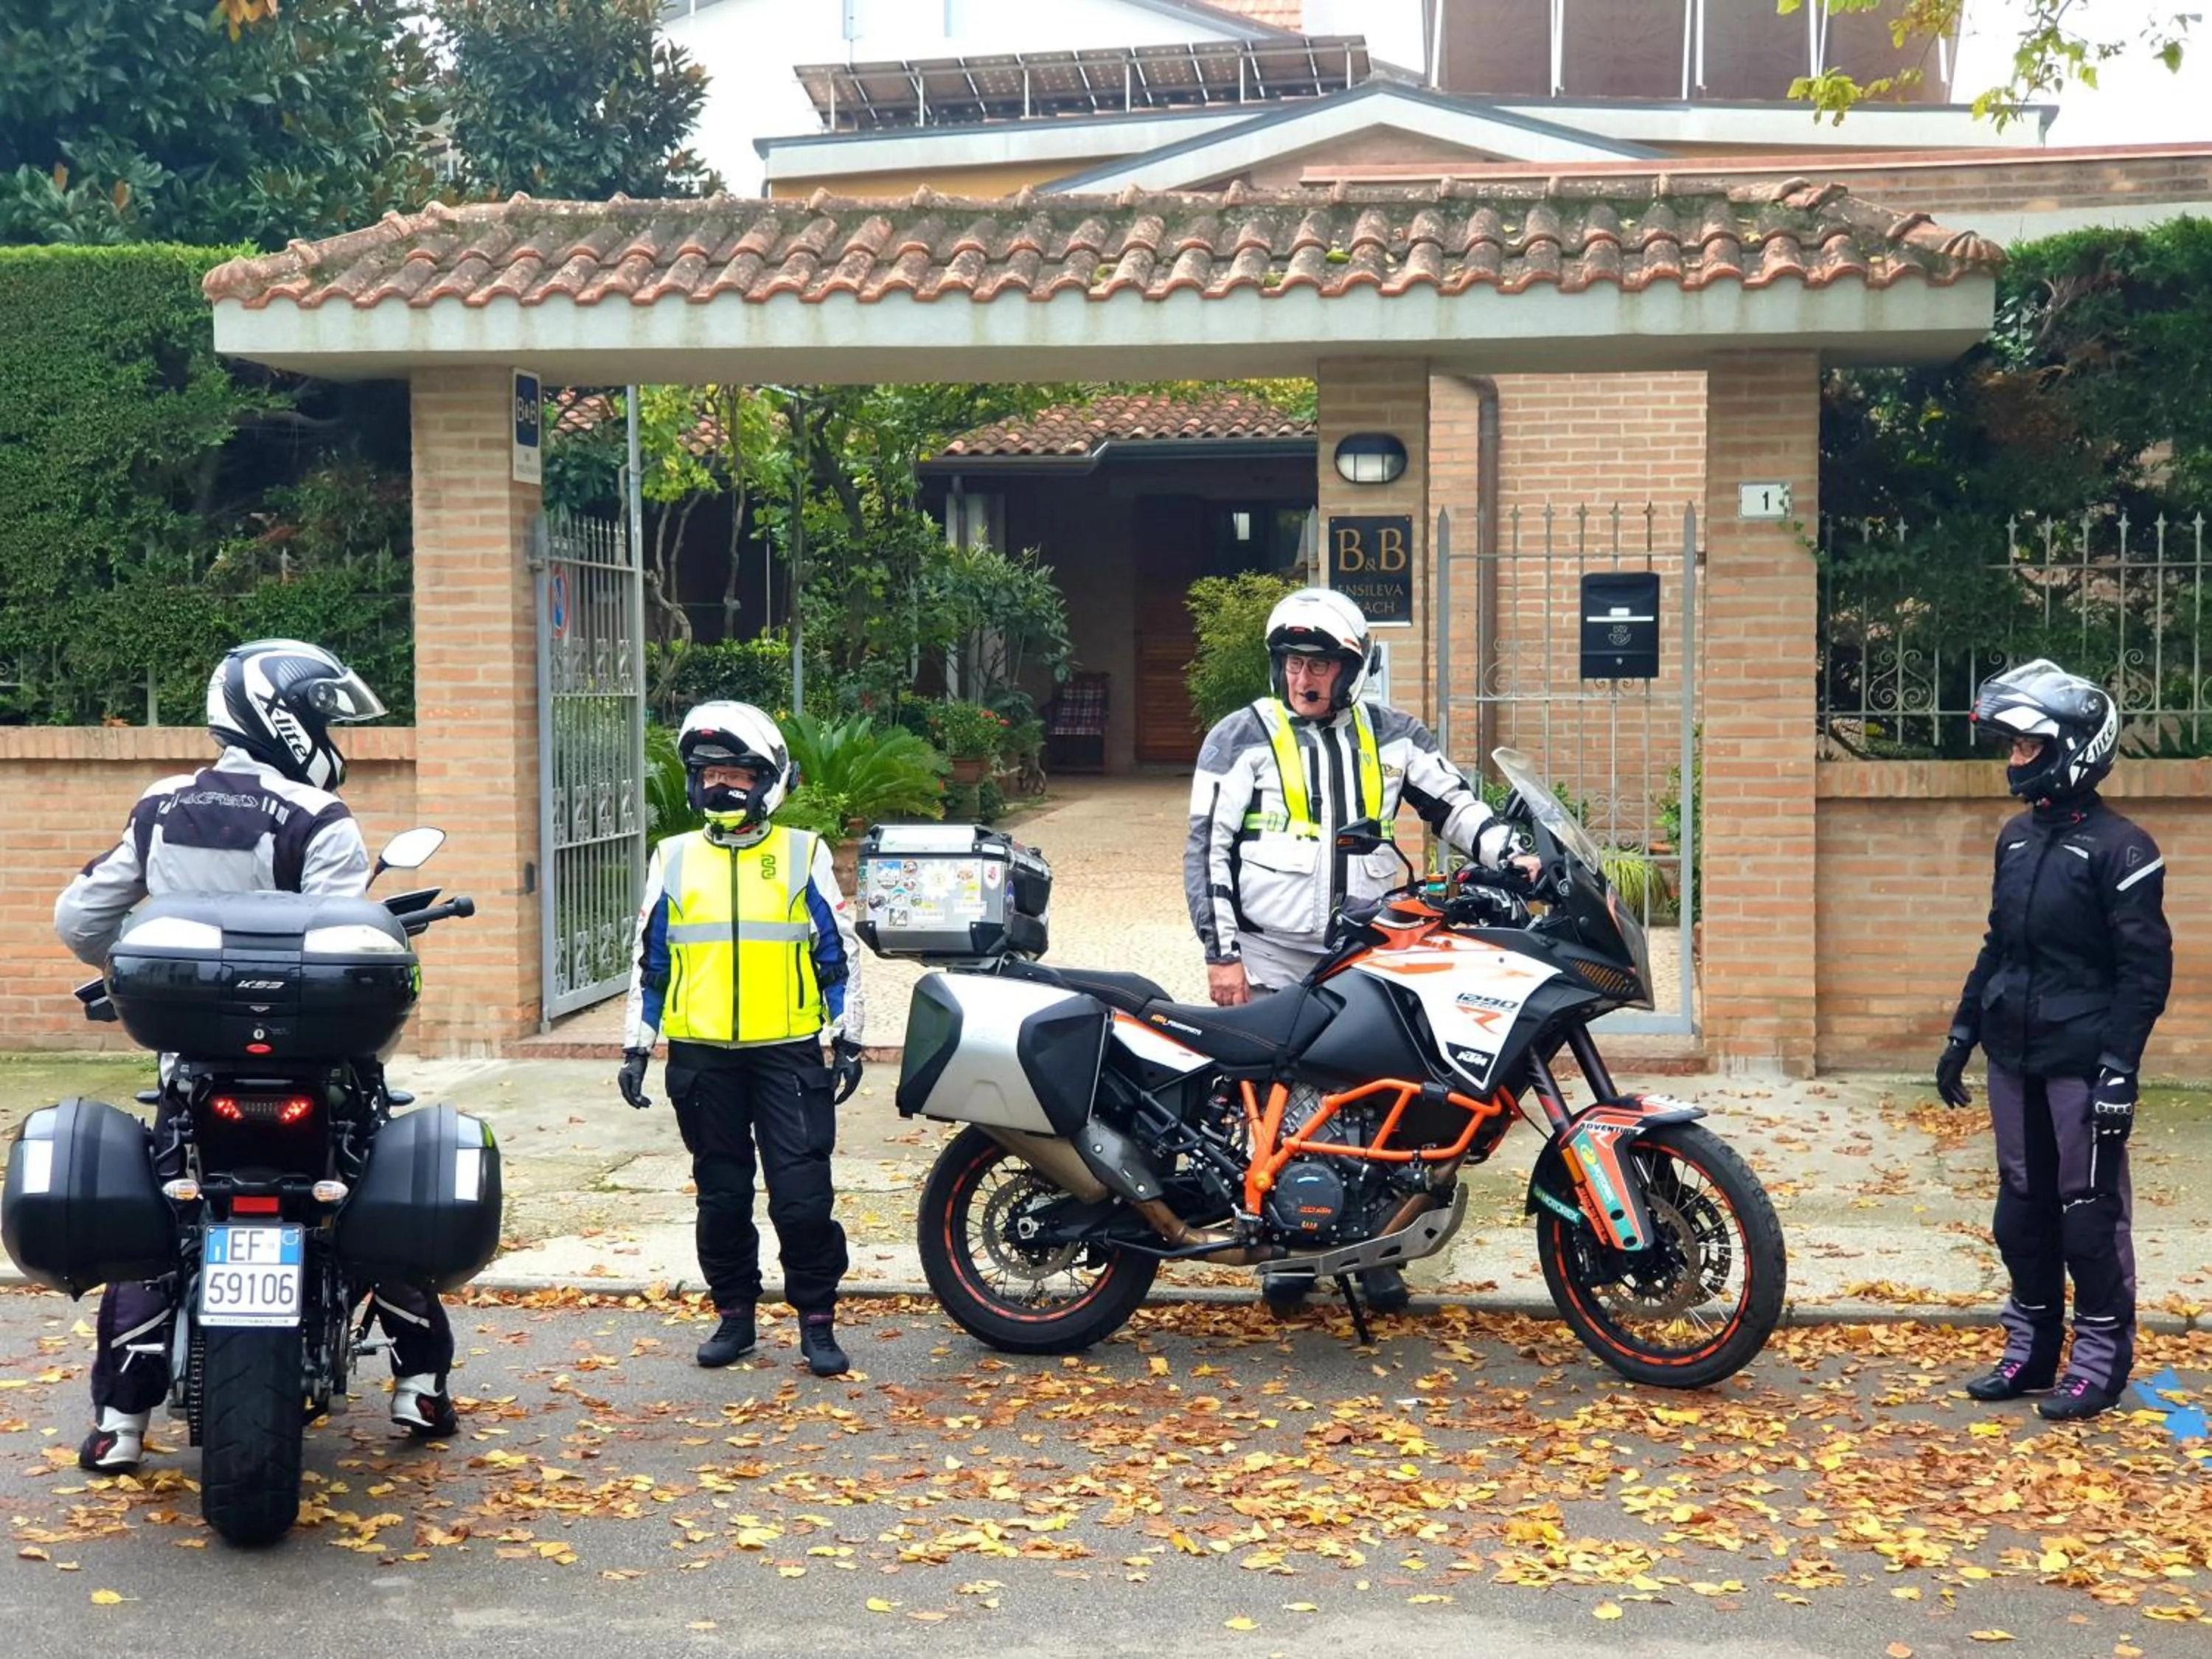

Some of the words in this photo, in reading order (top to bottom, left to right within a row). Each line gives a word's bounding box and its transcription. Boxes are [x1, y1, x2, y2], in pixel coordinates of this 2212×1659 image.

[517, 397, 537, 425] B&B
[1762, 491, 1769, 510] 1
[1335, 528, 1406, 571] B&B
[253, 687, 308, 758] X-lite
[1457, 992, 1520, 1009] 1290
[1456, 1051, 1488, 1067] KTM
[230, 1230, 264, 1261] EF
[209, 1273, 293, 1304] 59106
